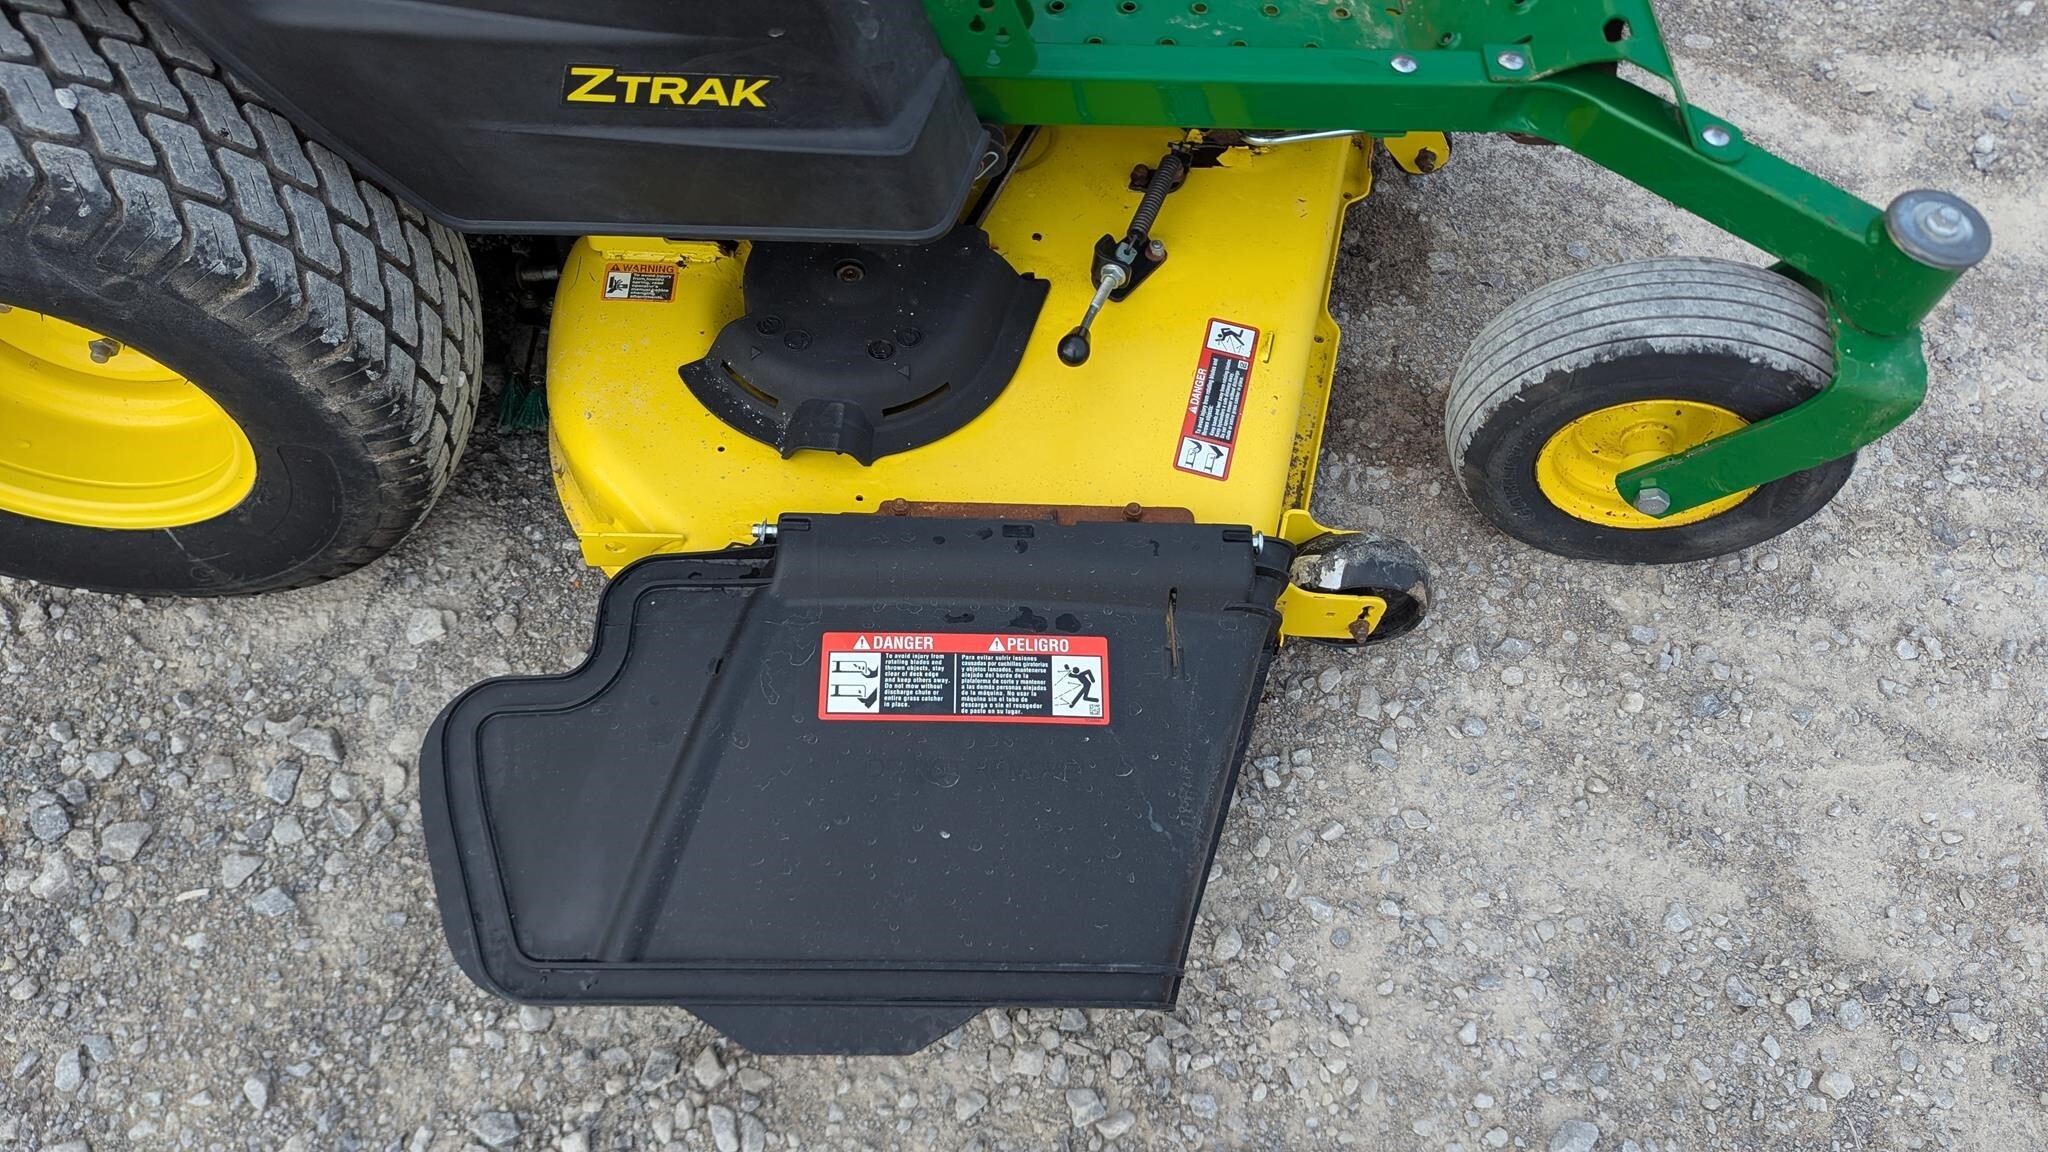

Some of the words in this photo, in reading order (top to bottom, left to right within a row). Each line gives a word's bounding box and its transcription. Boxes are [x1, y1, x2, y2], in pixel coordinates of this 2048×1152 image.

[567, 67, 770, 107] ZTRAK
[624, 264, 674, 272] WARNING
[1191, 368, 1207, 405] DANGER
[873, 636, 934, 650] DANGER
[1008, 638, 1069, 652] PELIGRO
